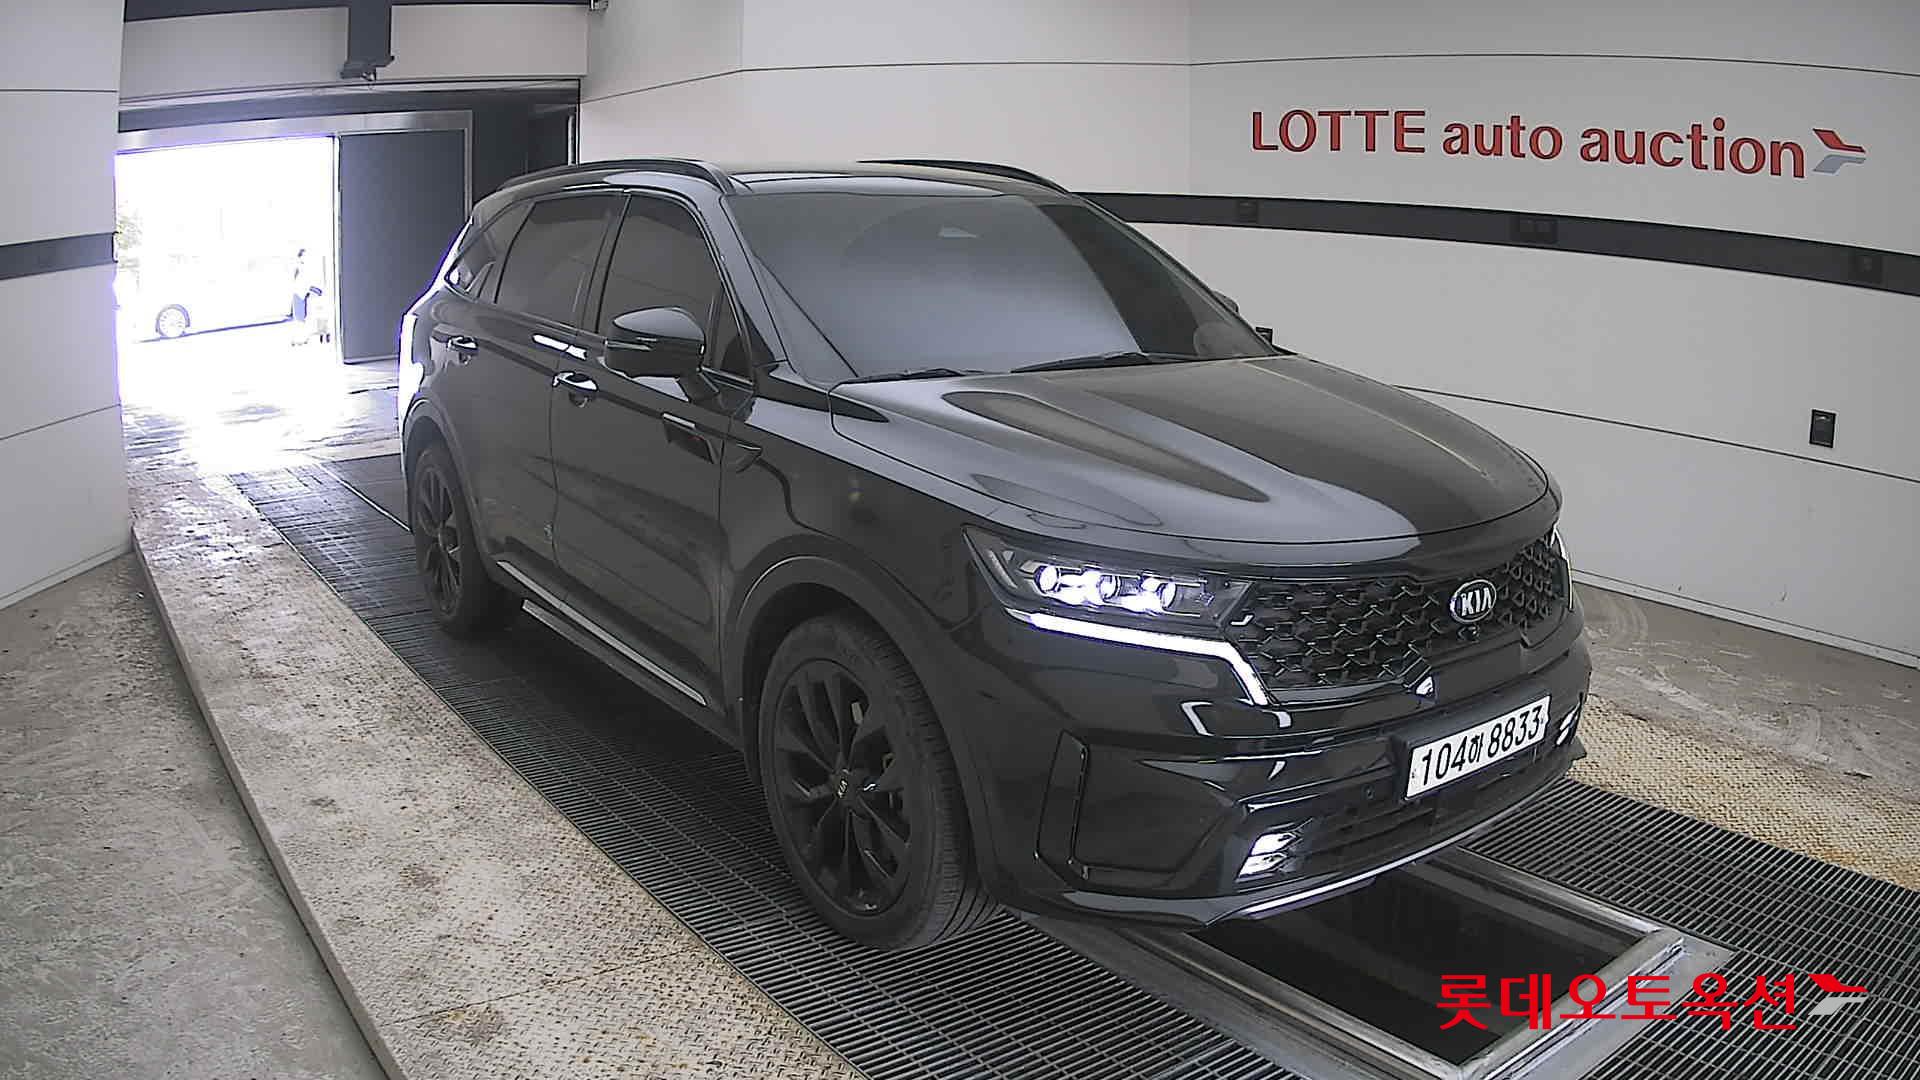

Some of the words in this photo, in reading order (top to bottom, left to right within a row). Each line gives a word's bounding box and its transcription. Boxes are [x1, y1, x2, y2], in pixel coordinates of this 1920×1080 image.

[1251, 109, 1426, 153] LOTTE
[1442, 115, 1563, 160] auto
[1579, 117, 1805, 179] auction
[1460, 586, 1492, 617] KIA
